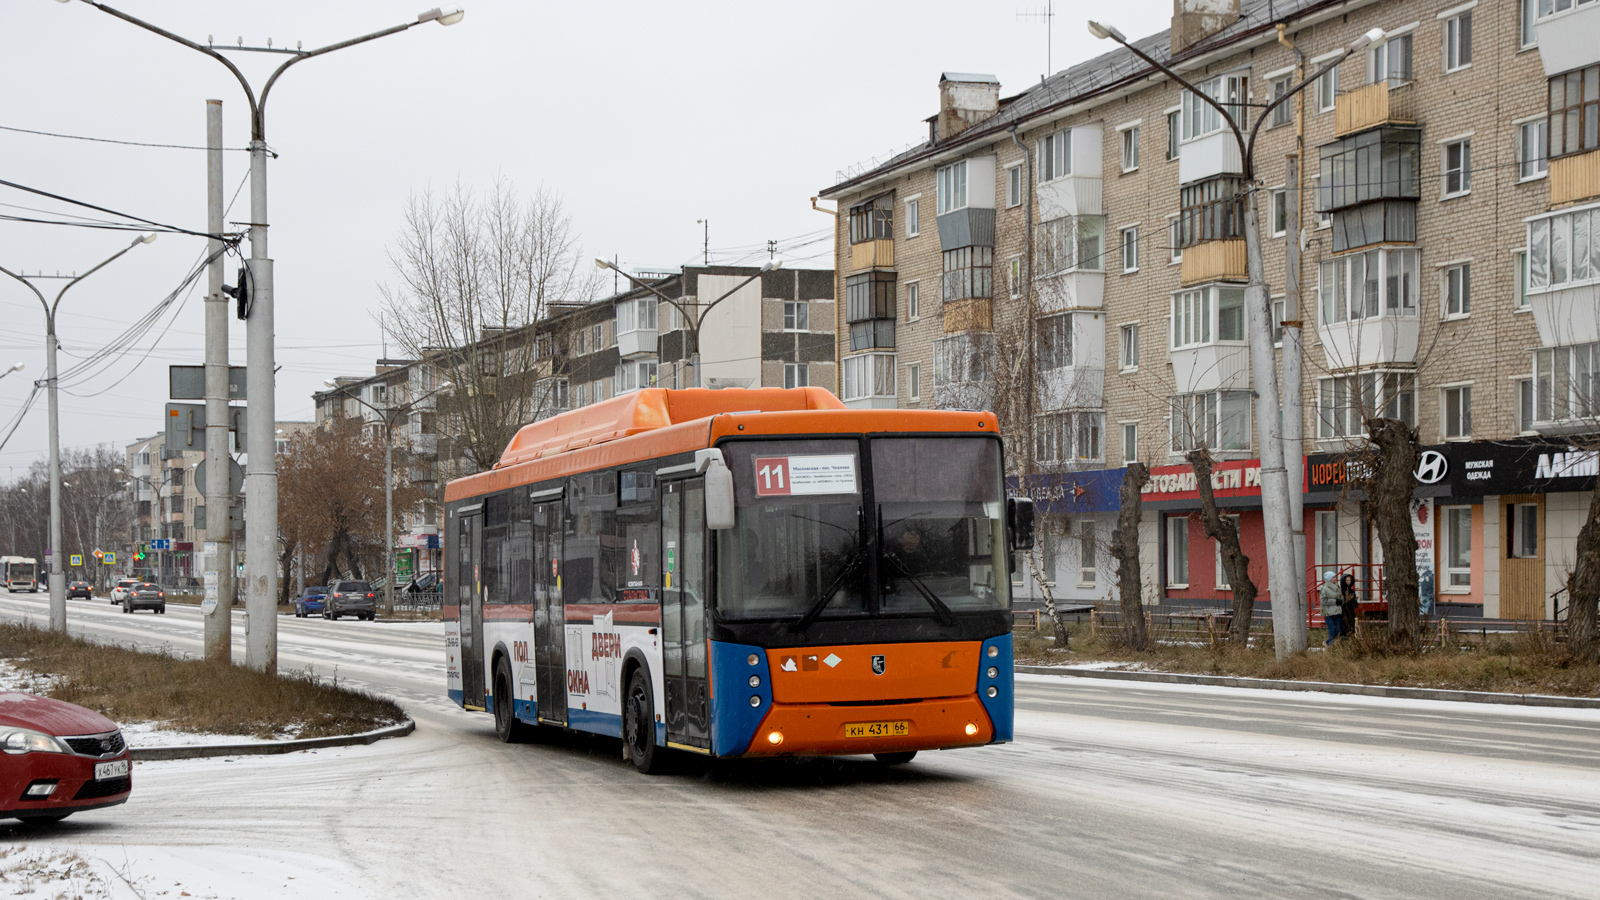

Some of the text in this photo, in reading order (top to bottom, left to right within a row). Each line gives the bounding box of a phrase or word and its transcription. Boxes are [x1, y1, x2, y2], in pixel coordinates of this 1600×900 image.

[1465, 459, 1494, 470] МУЖСКАЯ
[1535, 446, 1599, 479] ЛАЙМ
[759, 464, 785, 489] 11
[1141, 469, 1241, 494] ВТОЗАПСТИ
[1466, 470, 1492, 481] ОДЕЖДА
[1417, 539, 1432, 550] RON
[513, 641, 529, 663] ПОЛ
[592, 632, 621, 661] ДВЕРИ
[567, 669, 590, 694] ОКНА
[851, 722, 905, 736] КН 431 66
